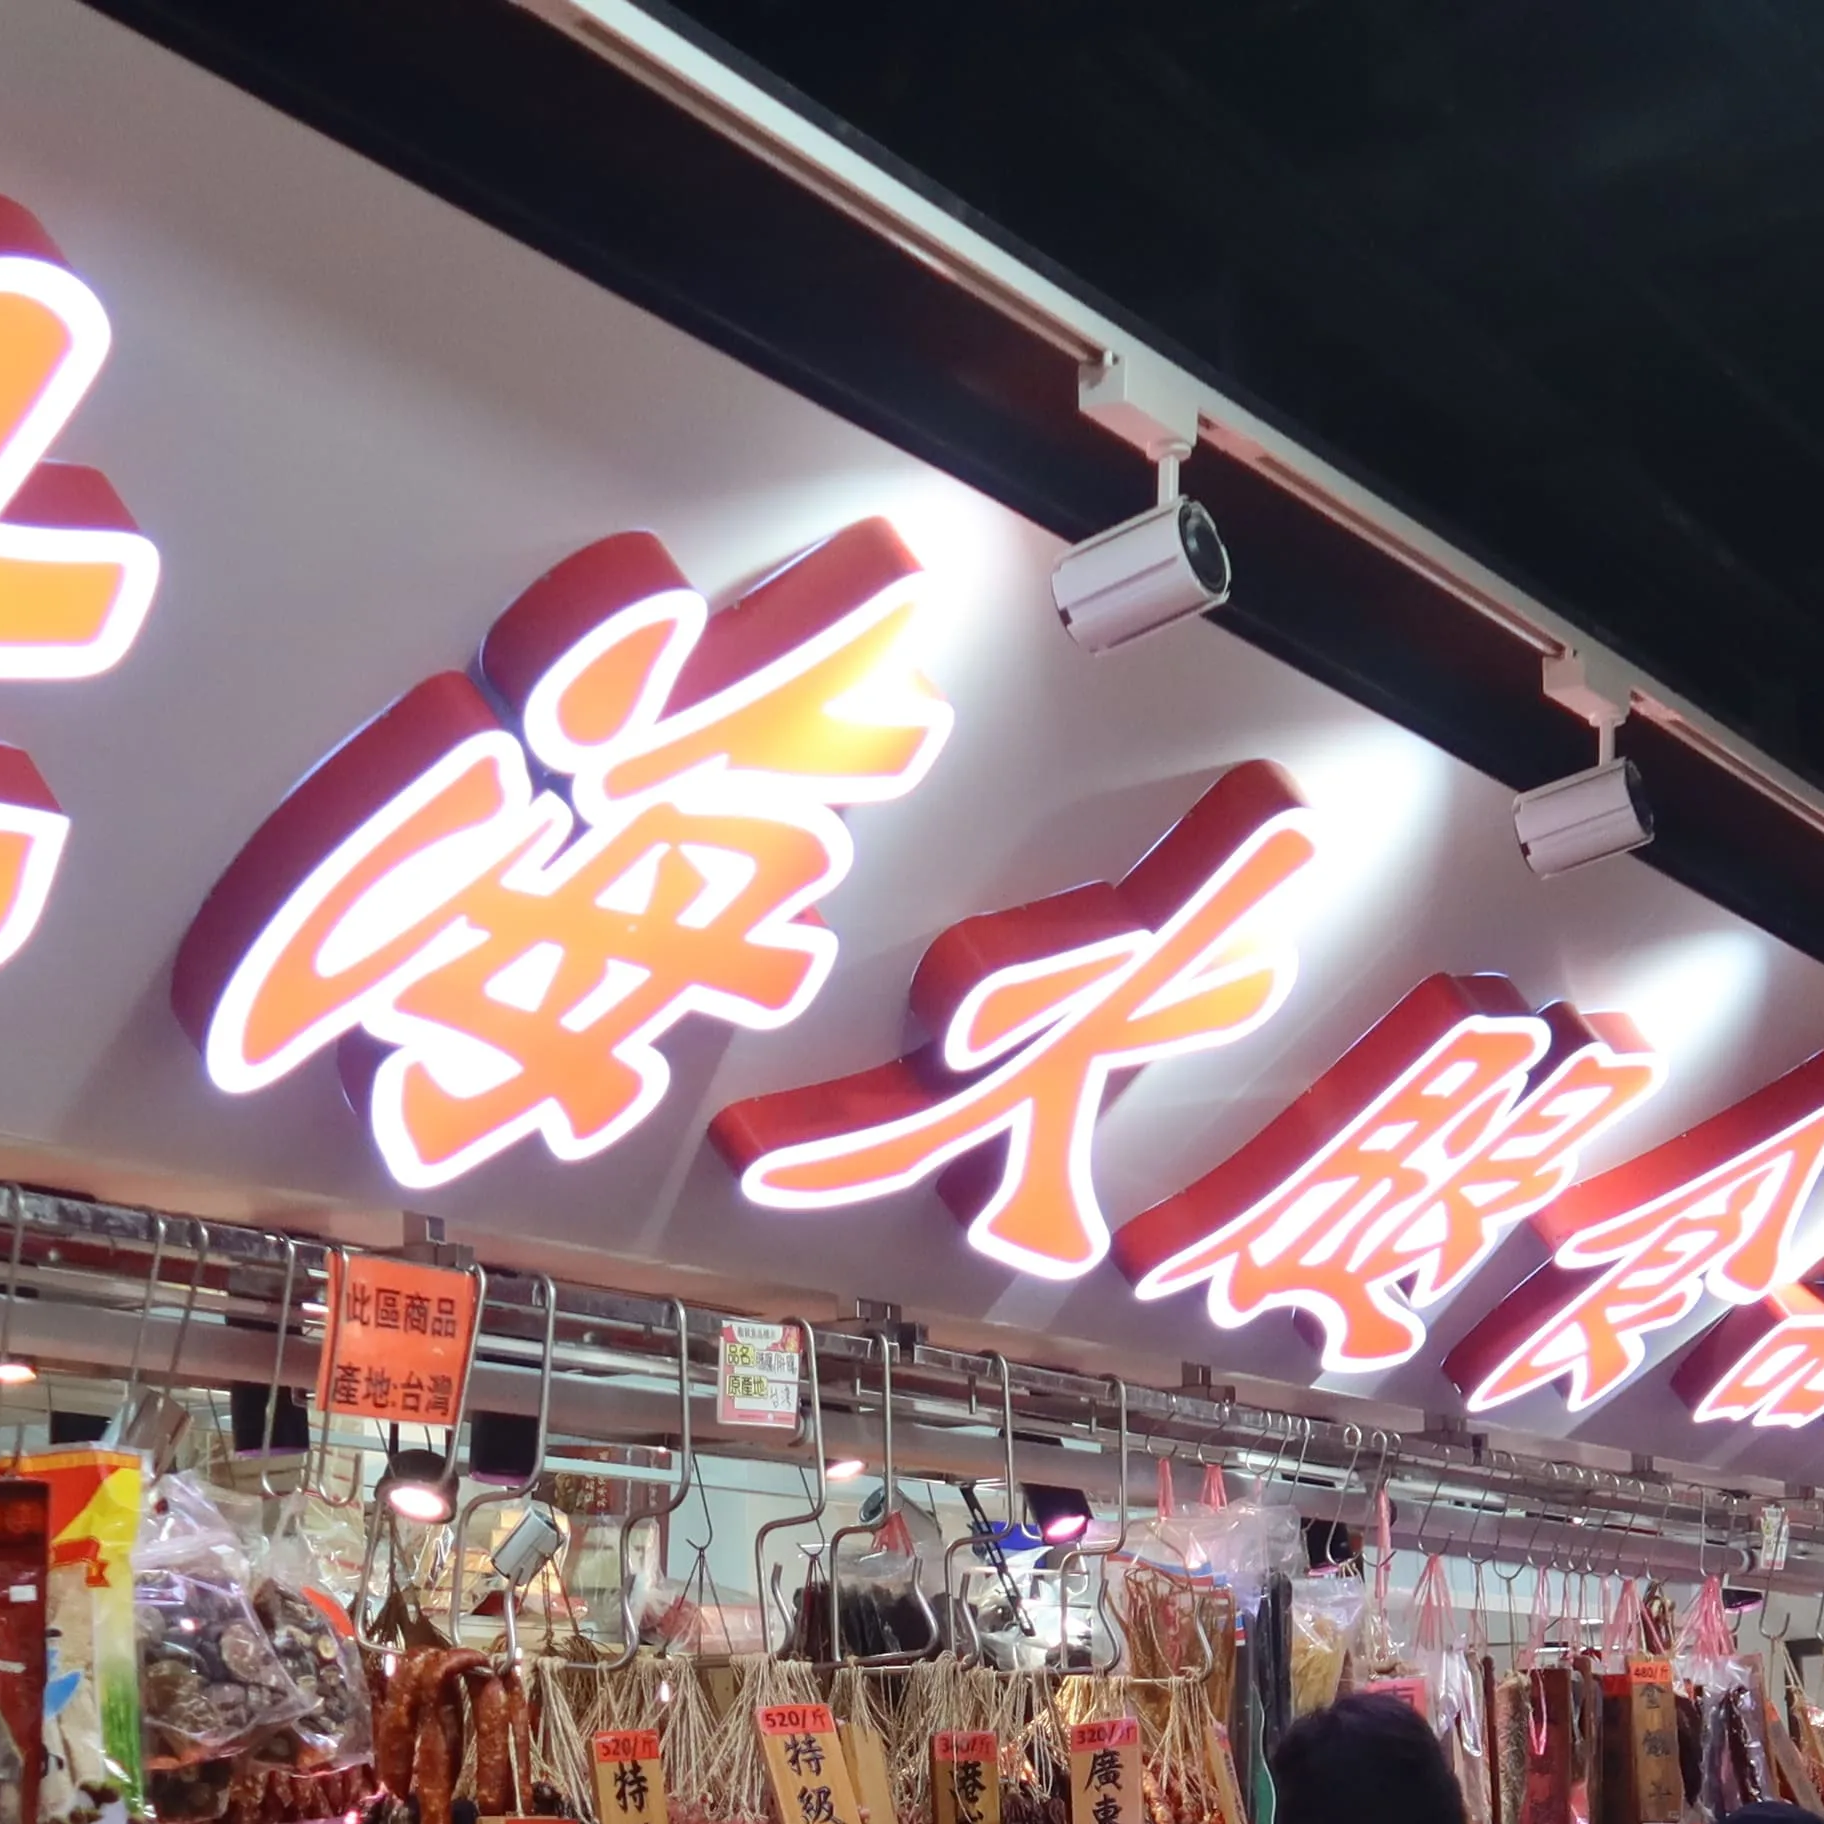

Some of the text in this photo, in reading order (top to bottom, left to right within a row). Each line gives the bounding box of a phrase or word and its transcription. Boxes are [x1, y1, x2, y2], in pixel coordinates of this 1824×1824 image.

[345, 1280, 459, 1339] 此區商品
[332, 1361, 455, 1416] 產地:台灣
[764, 1707, 827, 1730] 520/斤
